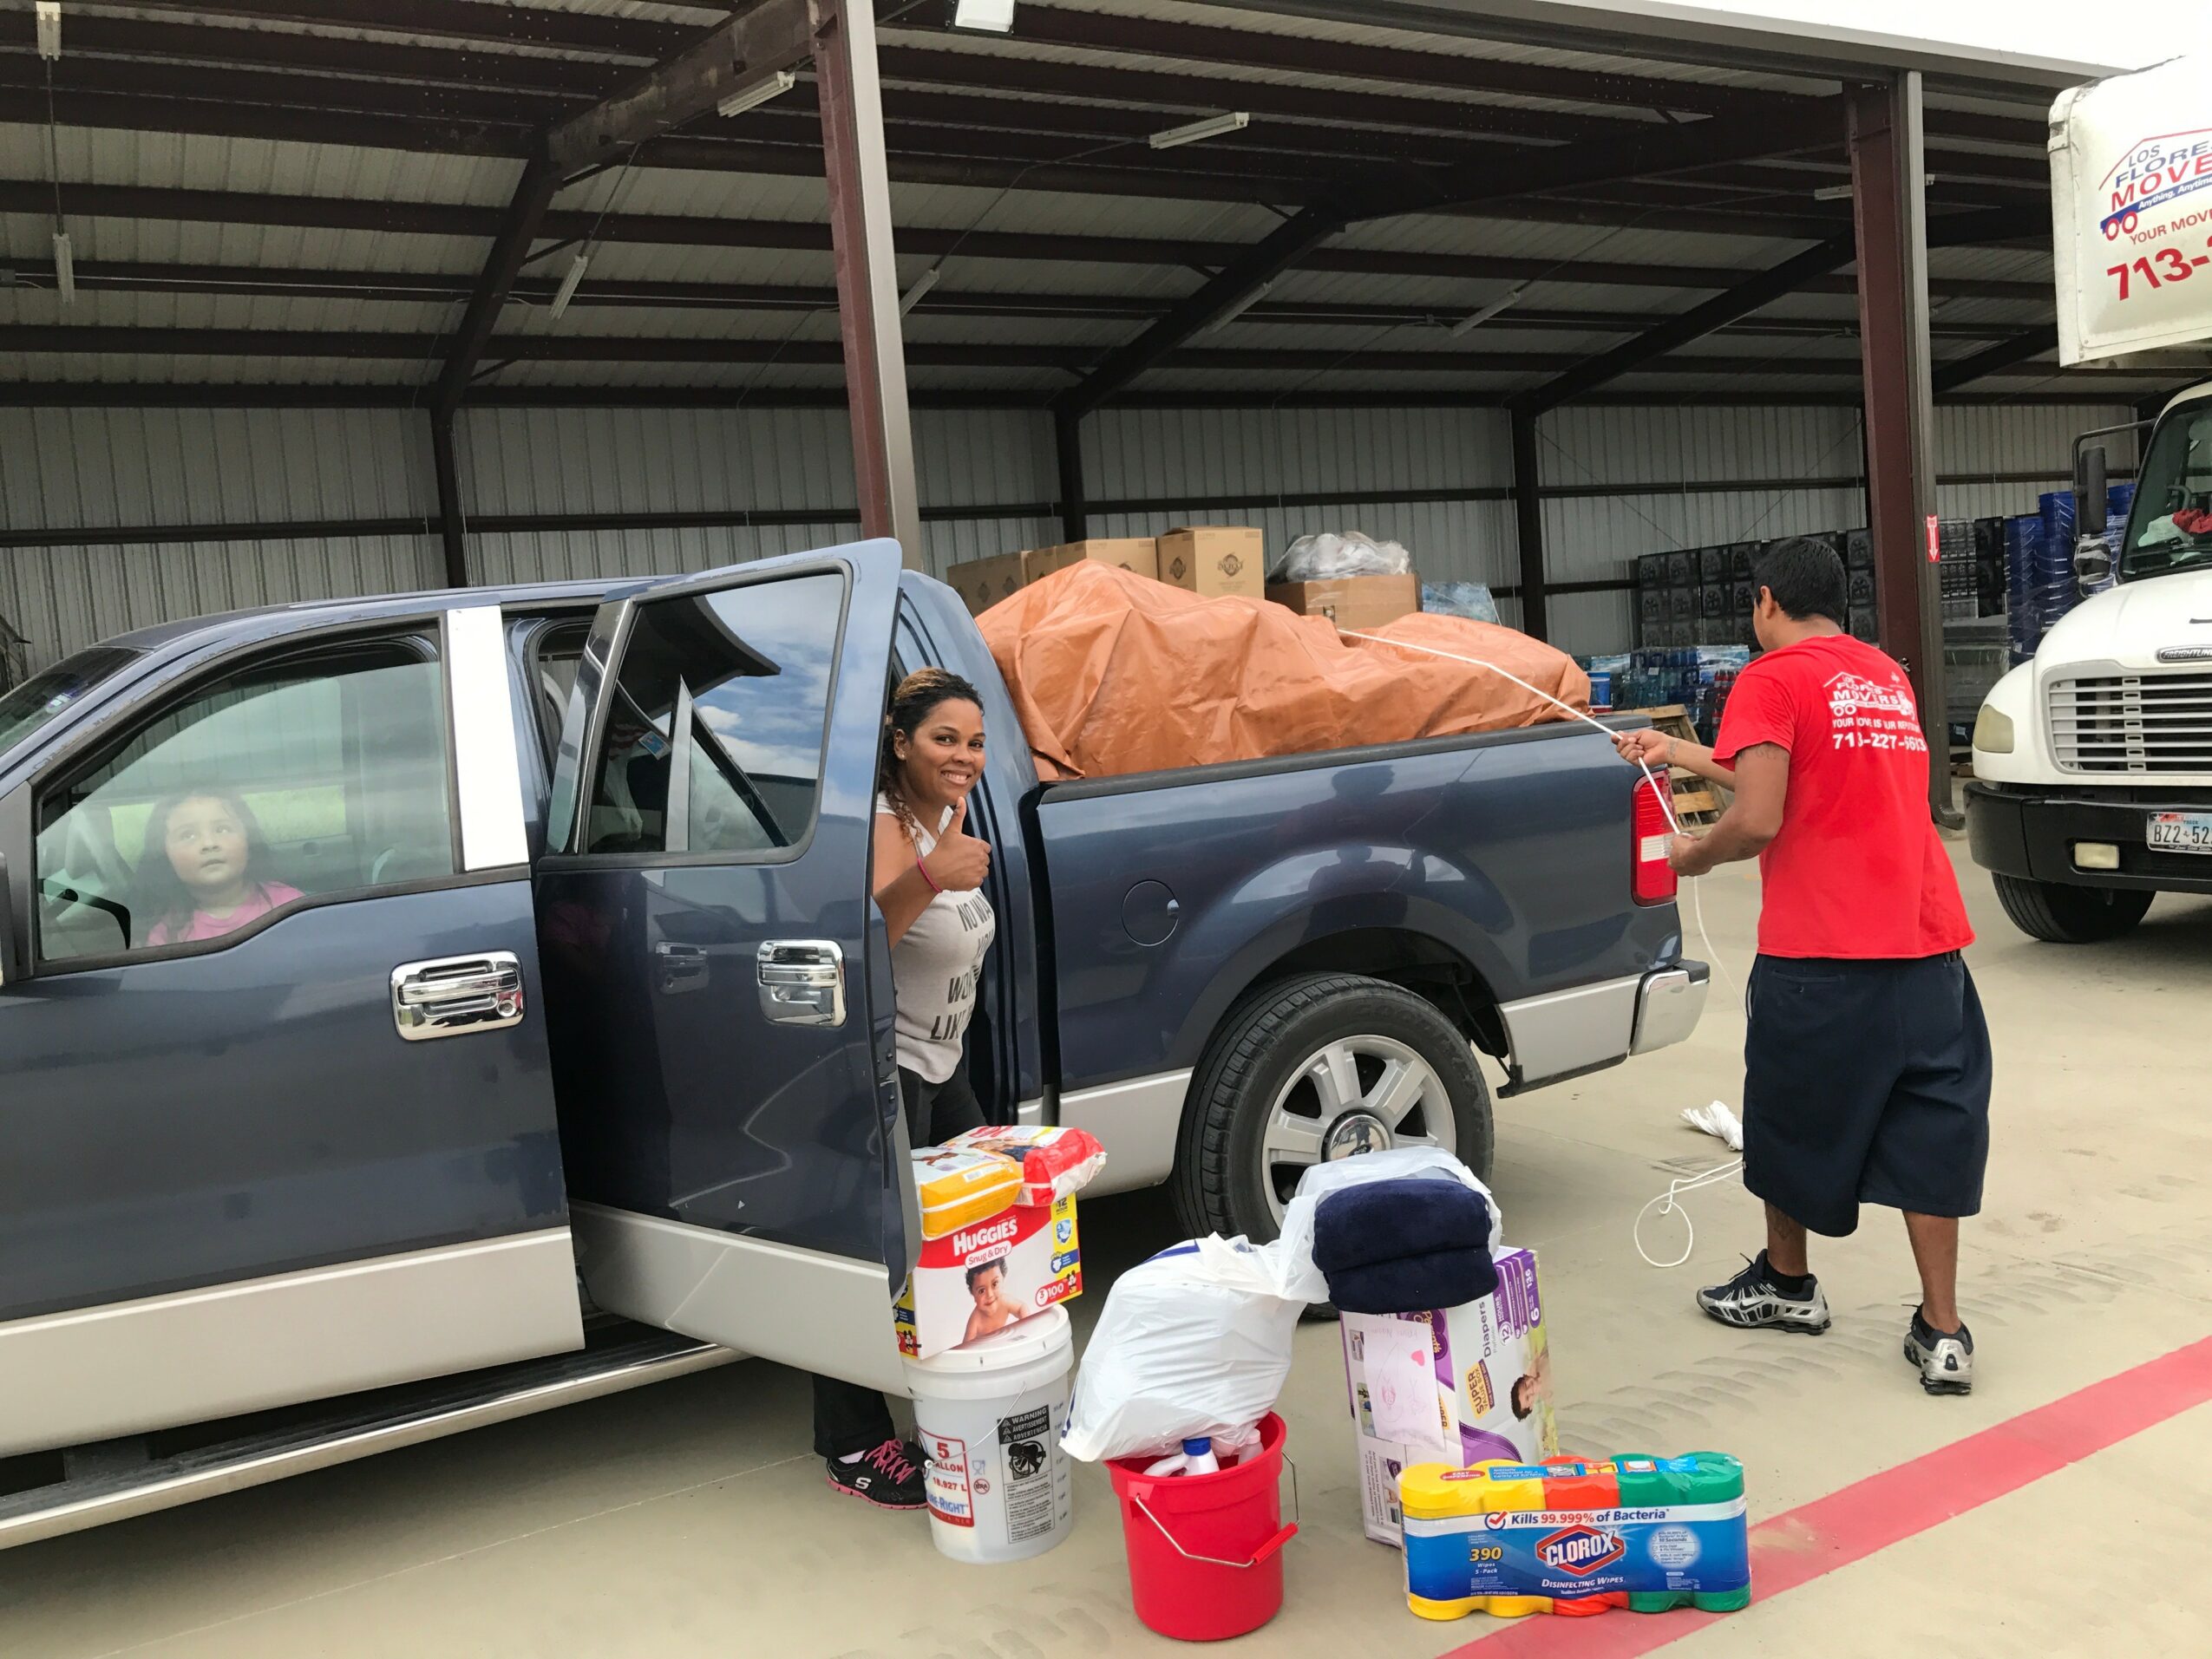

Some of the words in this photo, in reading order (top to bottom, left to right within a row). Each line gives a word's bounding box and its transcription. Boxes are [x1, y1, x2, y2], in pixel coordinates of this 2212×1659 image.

[2116, 140, 2212, 189] FLORE
[2128, 144, 2160, 168] LOS
[2130, 224, 2167, 245] YOUR
[2106, 235, 2212, 301] 713-
[1833, 717, 1854, 728] YOUR
[1874, 719, 1882, 728] IS
[2154, 824, 2181, 843] BZ2
[2192, 826, 2212, 845] 52
[957, 904, 977, 932] NO
[953, 1218, 1018, 1257] HUGGIES
[968, 1252, 988, 1265] Snug
[994, 1245, 1008, 1255] Dry
[1525, 1268, 1534, 1289] 136
[1039, 1289, 1045, 1299] 3
[1048, 1283, 1064, 1298] 100
[1530, 1308, 1540, 1321] 6
[1478, 1302, 1492, 1358] Diapers
[1502, 1327, 1509, 1342] 12
[1467, 1370, 1484, 1414] SUPER
[1011, 1408, 1047, 1424] WARNING
[1013, 1425, 1048, 1440] ADVERTENCIA
[937, 1441, 950, 1459] 5
[1512, 1513, 1539, 1525] Kills
[1541, 1512, 1595, 1524] 99.999%
[1596, 1512, 1610, 1523] of
[1469, 1546, 1502, 1562] 390
[1546, 1531, 1616, 1568] CLOROX
[1541, 1578, 1595, 1589] DISINFECTING
[1598, 1577, 1624, 1585] WIPES
